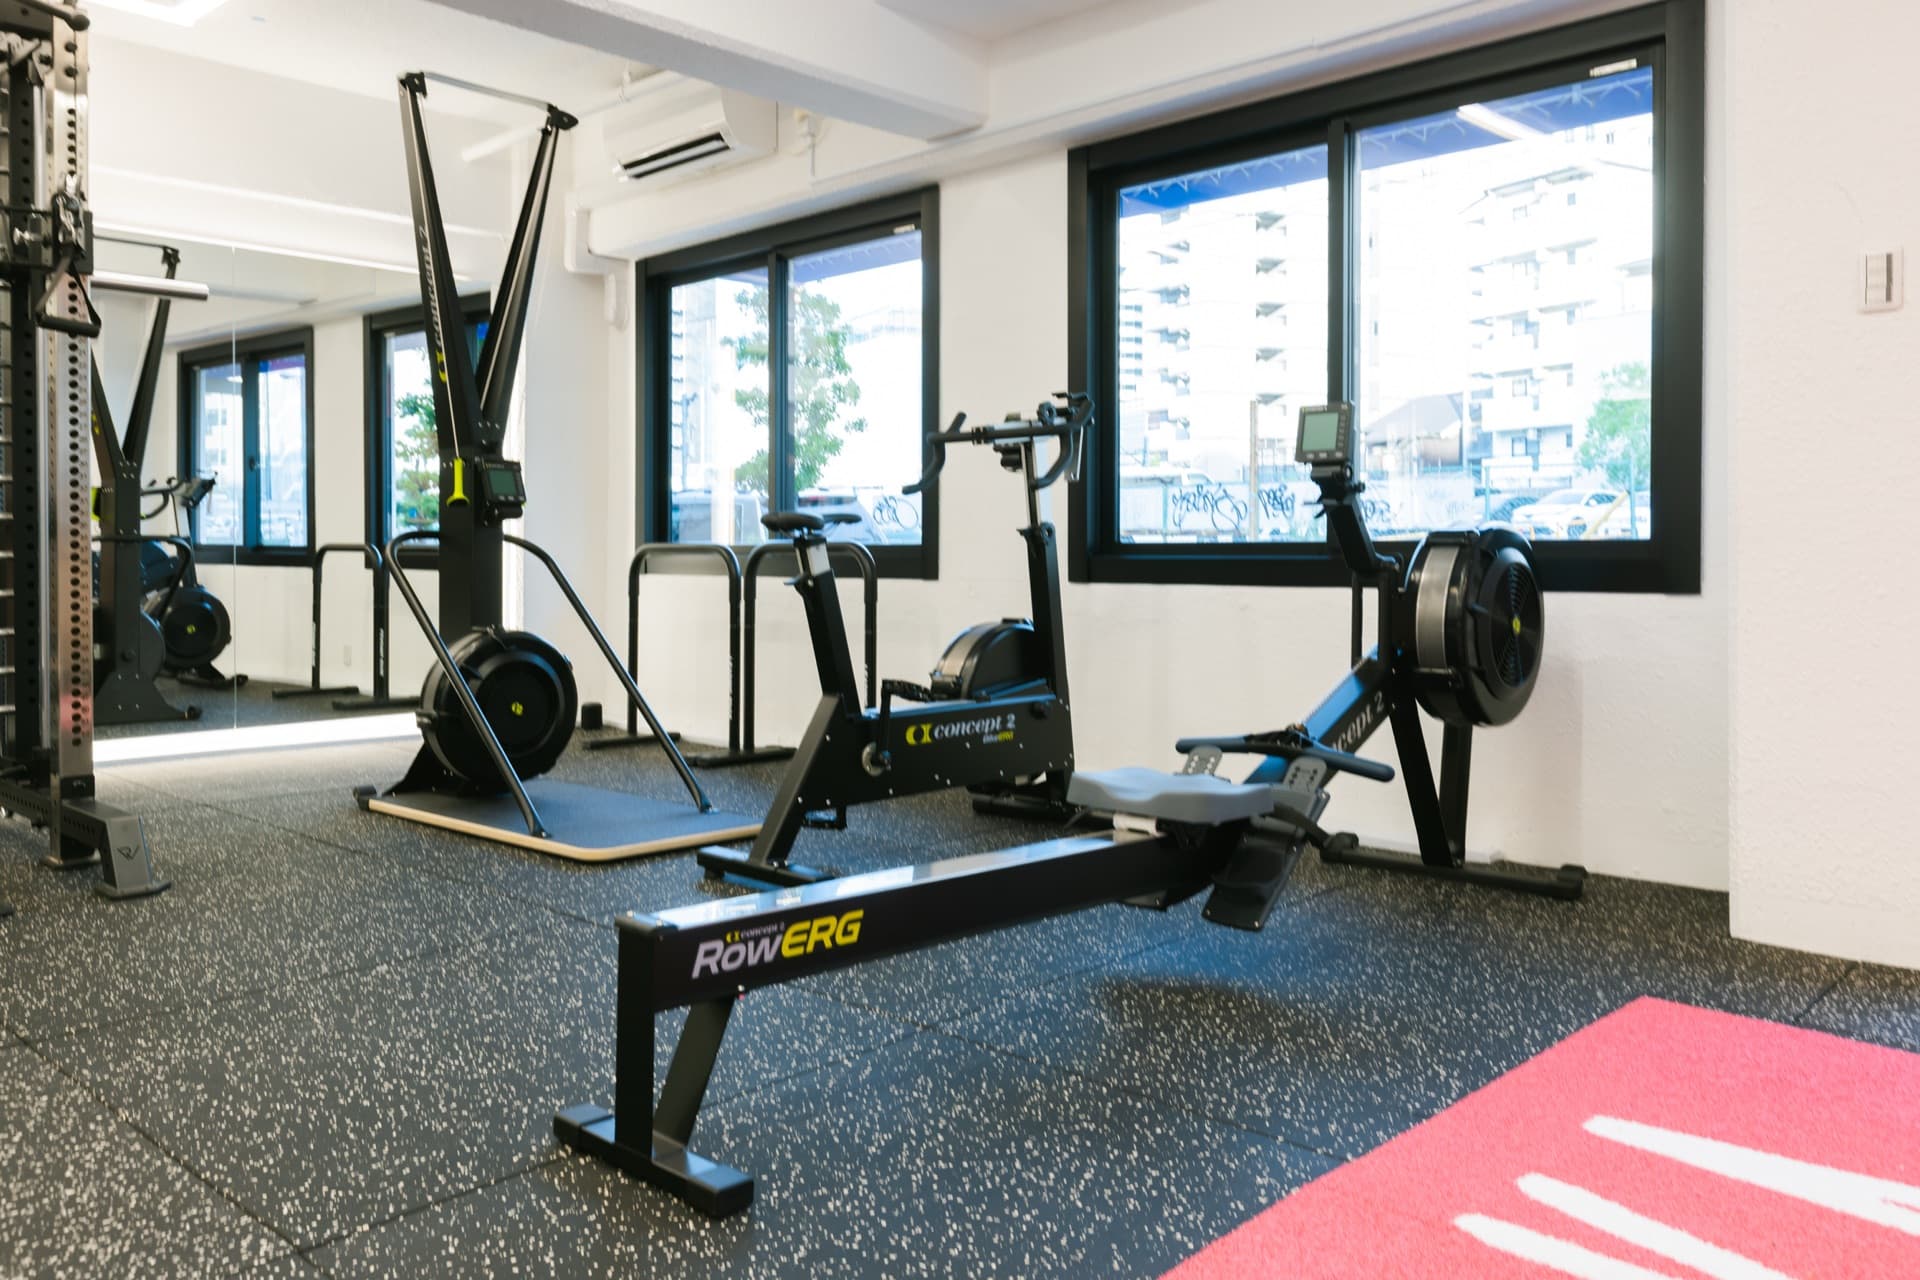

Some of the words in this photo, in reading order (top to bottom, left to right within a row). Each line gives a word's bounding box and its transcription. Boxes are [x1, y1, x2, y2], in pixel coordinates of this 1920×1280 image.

[1374, 690, 1384, 713] 2
[934, 716, 1002, 739] concept
[1006, 713, 1016, 729] 2
